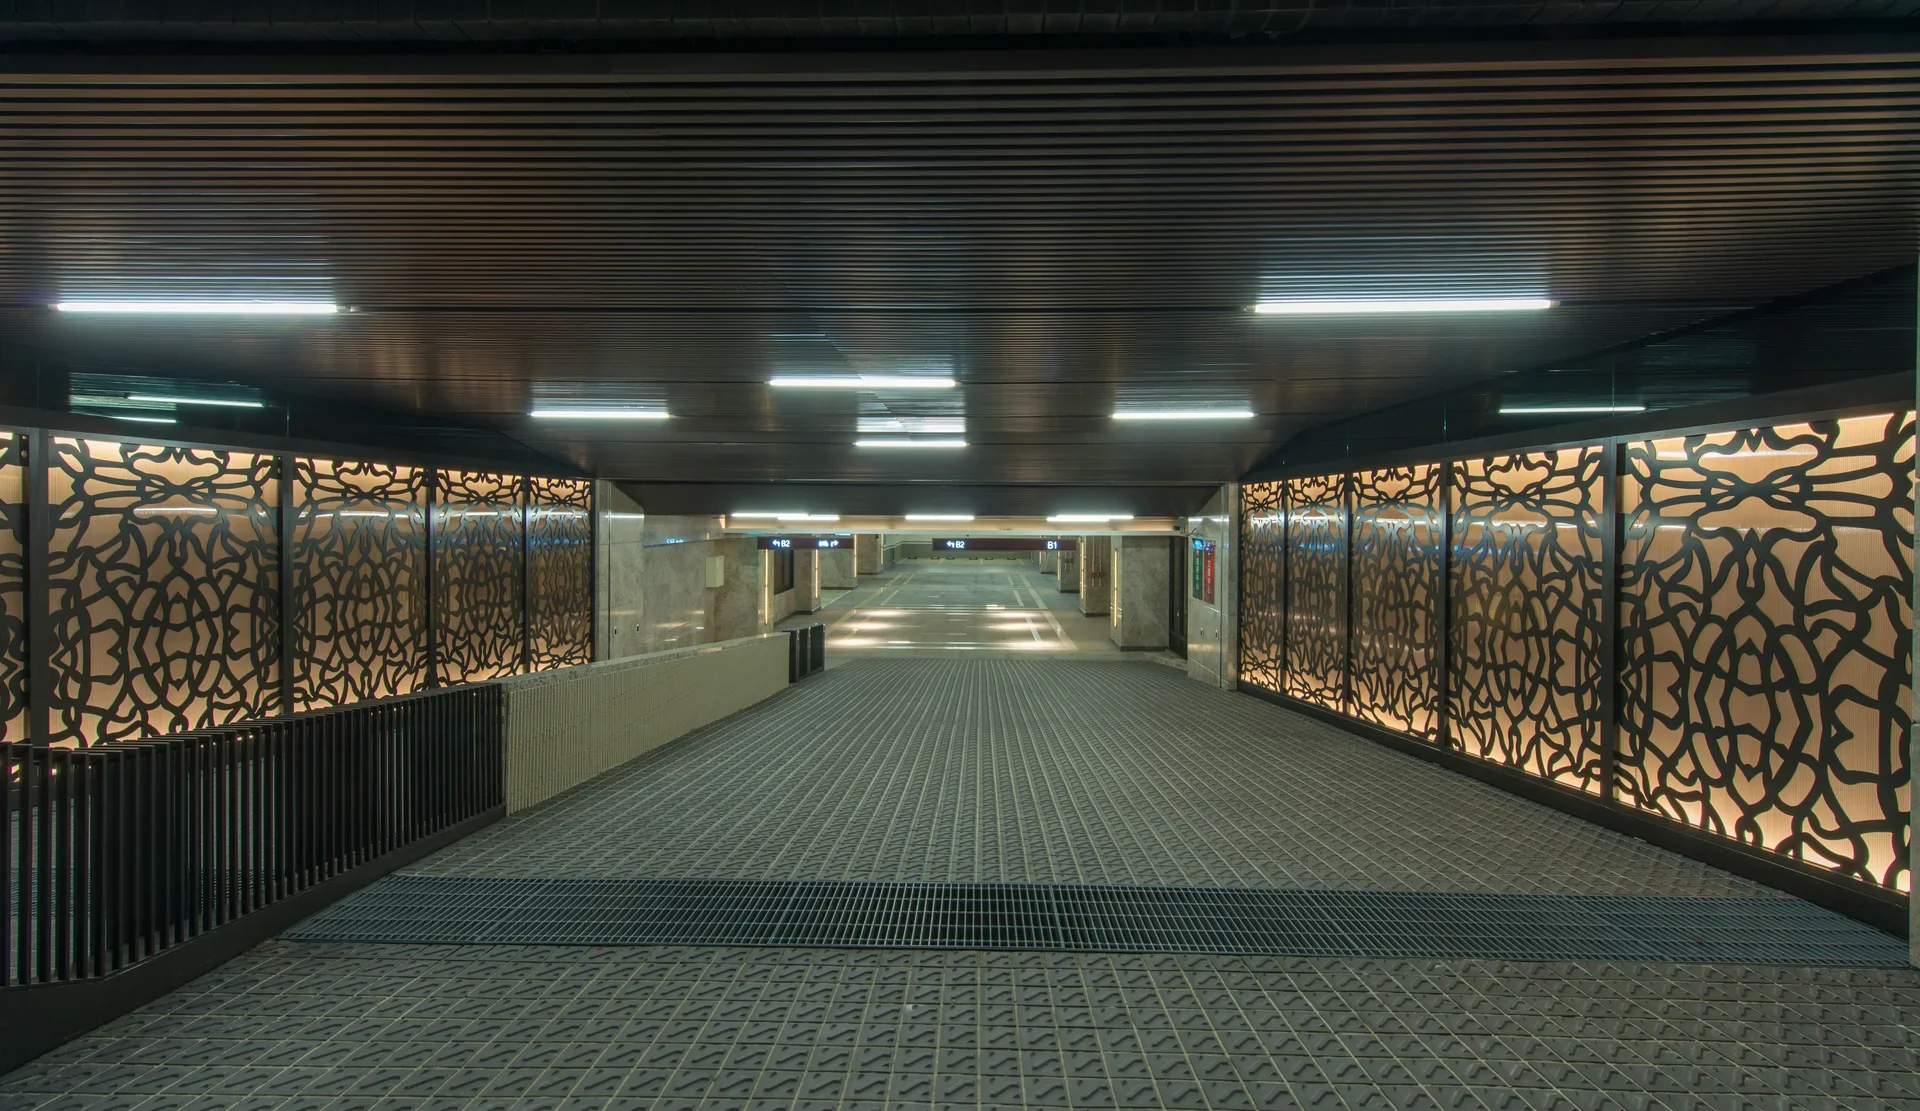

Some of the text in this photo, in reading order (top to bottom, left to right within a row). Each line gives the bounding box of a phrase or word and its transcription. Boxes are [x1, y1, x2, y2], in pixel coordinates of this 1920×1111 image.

[780, 539, 790, 548] B2
[955, 540, 965, 549] B2
[1047, 540, 1057, 550] B1
